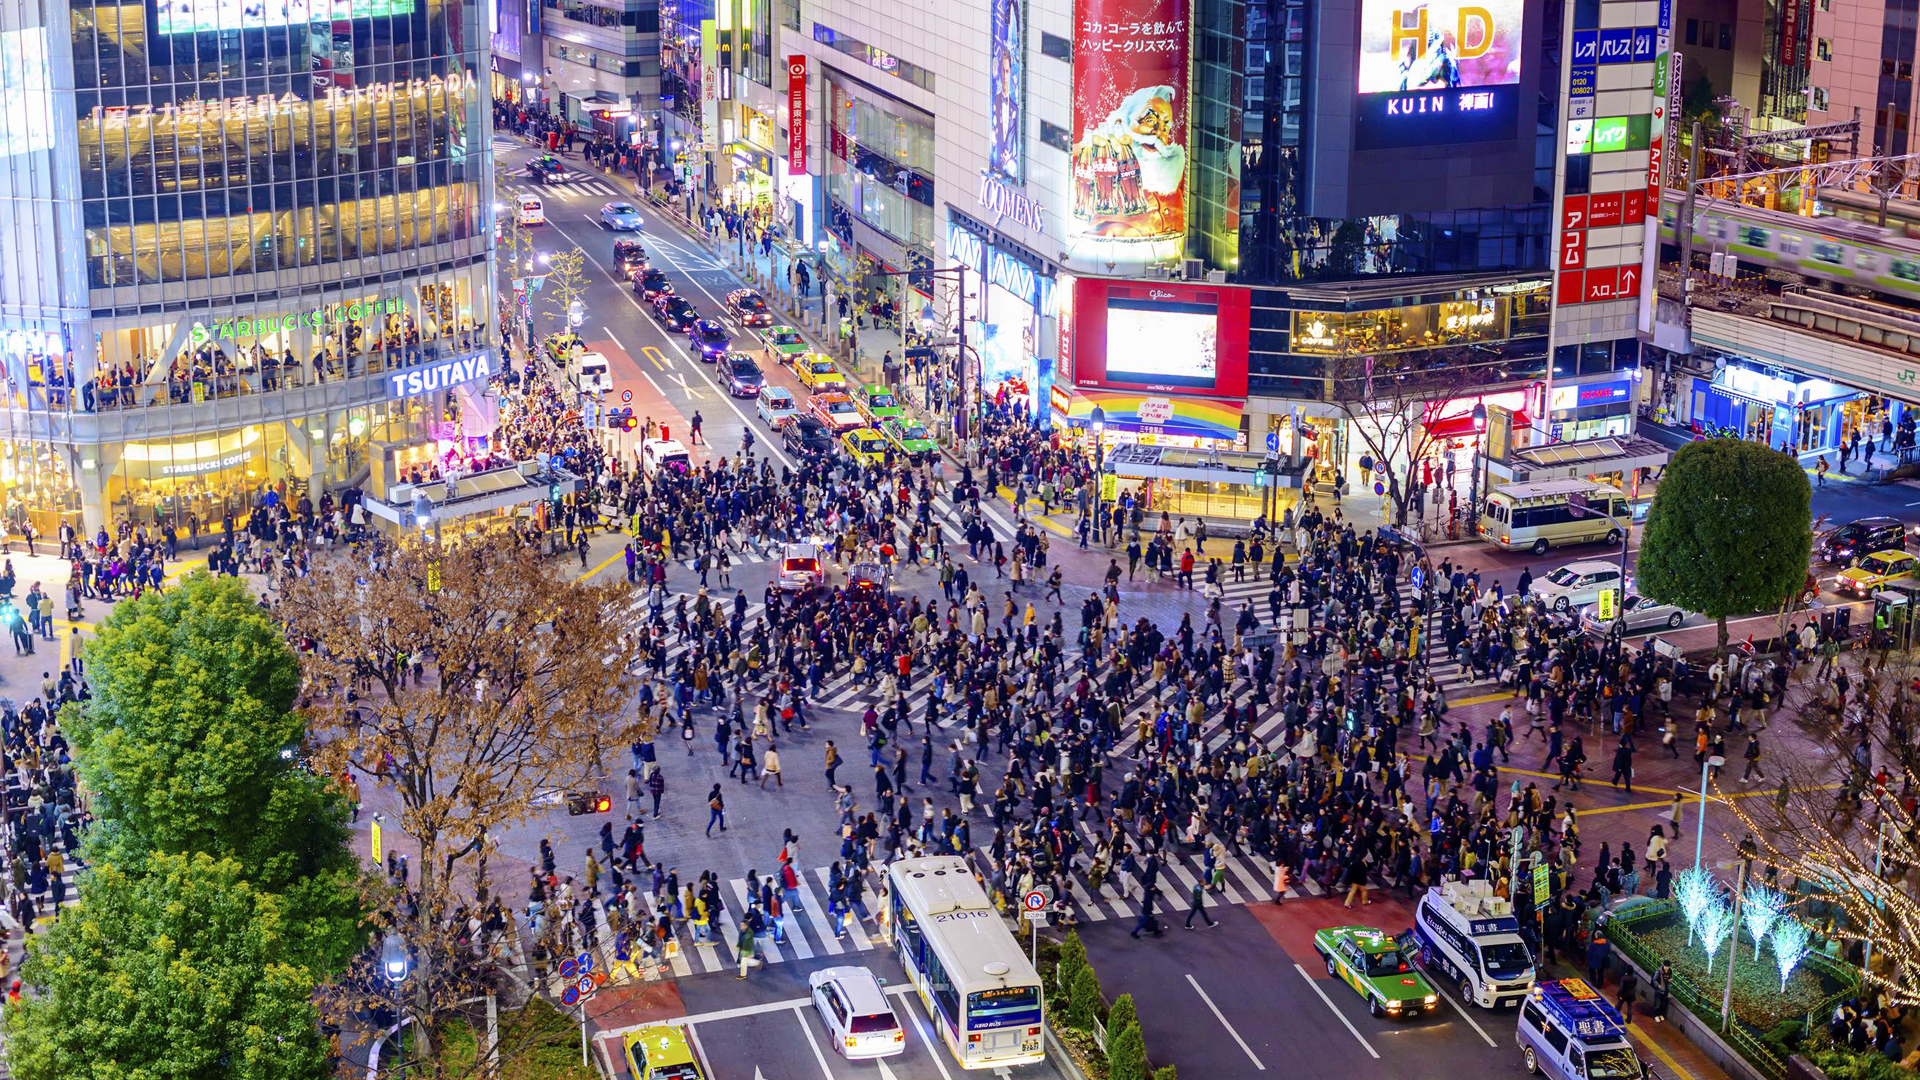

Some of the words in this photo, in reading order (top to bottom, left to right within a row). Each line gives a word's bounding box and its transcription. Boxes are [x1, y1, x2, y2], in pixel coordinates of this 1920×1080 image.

[1082, 20, 1185, 35] コカ・コーラを飲んで、
[1081, 39, 1179, 53] ハッピークリスマス。
[1575, 35, 1650, 58] レオパレス21
[1572, 78, 1587, 86] 0120
[1387, 96, 1444, 115] KUIN
[1576, 107, 1586, 115] 6F
[793, 90, 802, 168] 三菱東京UFJ銀行
[1593, 126, 1627, 143] レイク
[1650, 148, 1660, 186] アコム
[1565, 211, 1582, 264] アコム
[1149, 289, 1175, 300] Glico
[1591, 285, 1610, 297] 入口
[190, 309, 323, 343] STARBUCKS
[335, 294, 405, 323] COFFEE
[1301, 336, 1334, 346] COFFEE
[392, 355, 490, 397] TSUTAYA
[1897, 369, 1916, 383] JR
[1580, 387, 1612, 401] PROMISE
[162, 460, 222, 474] STARBUCKS
[223, 450, 251, 466] COFFEE
[936, 910, 989, 923] 21016
